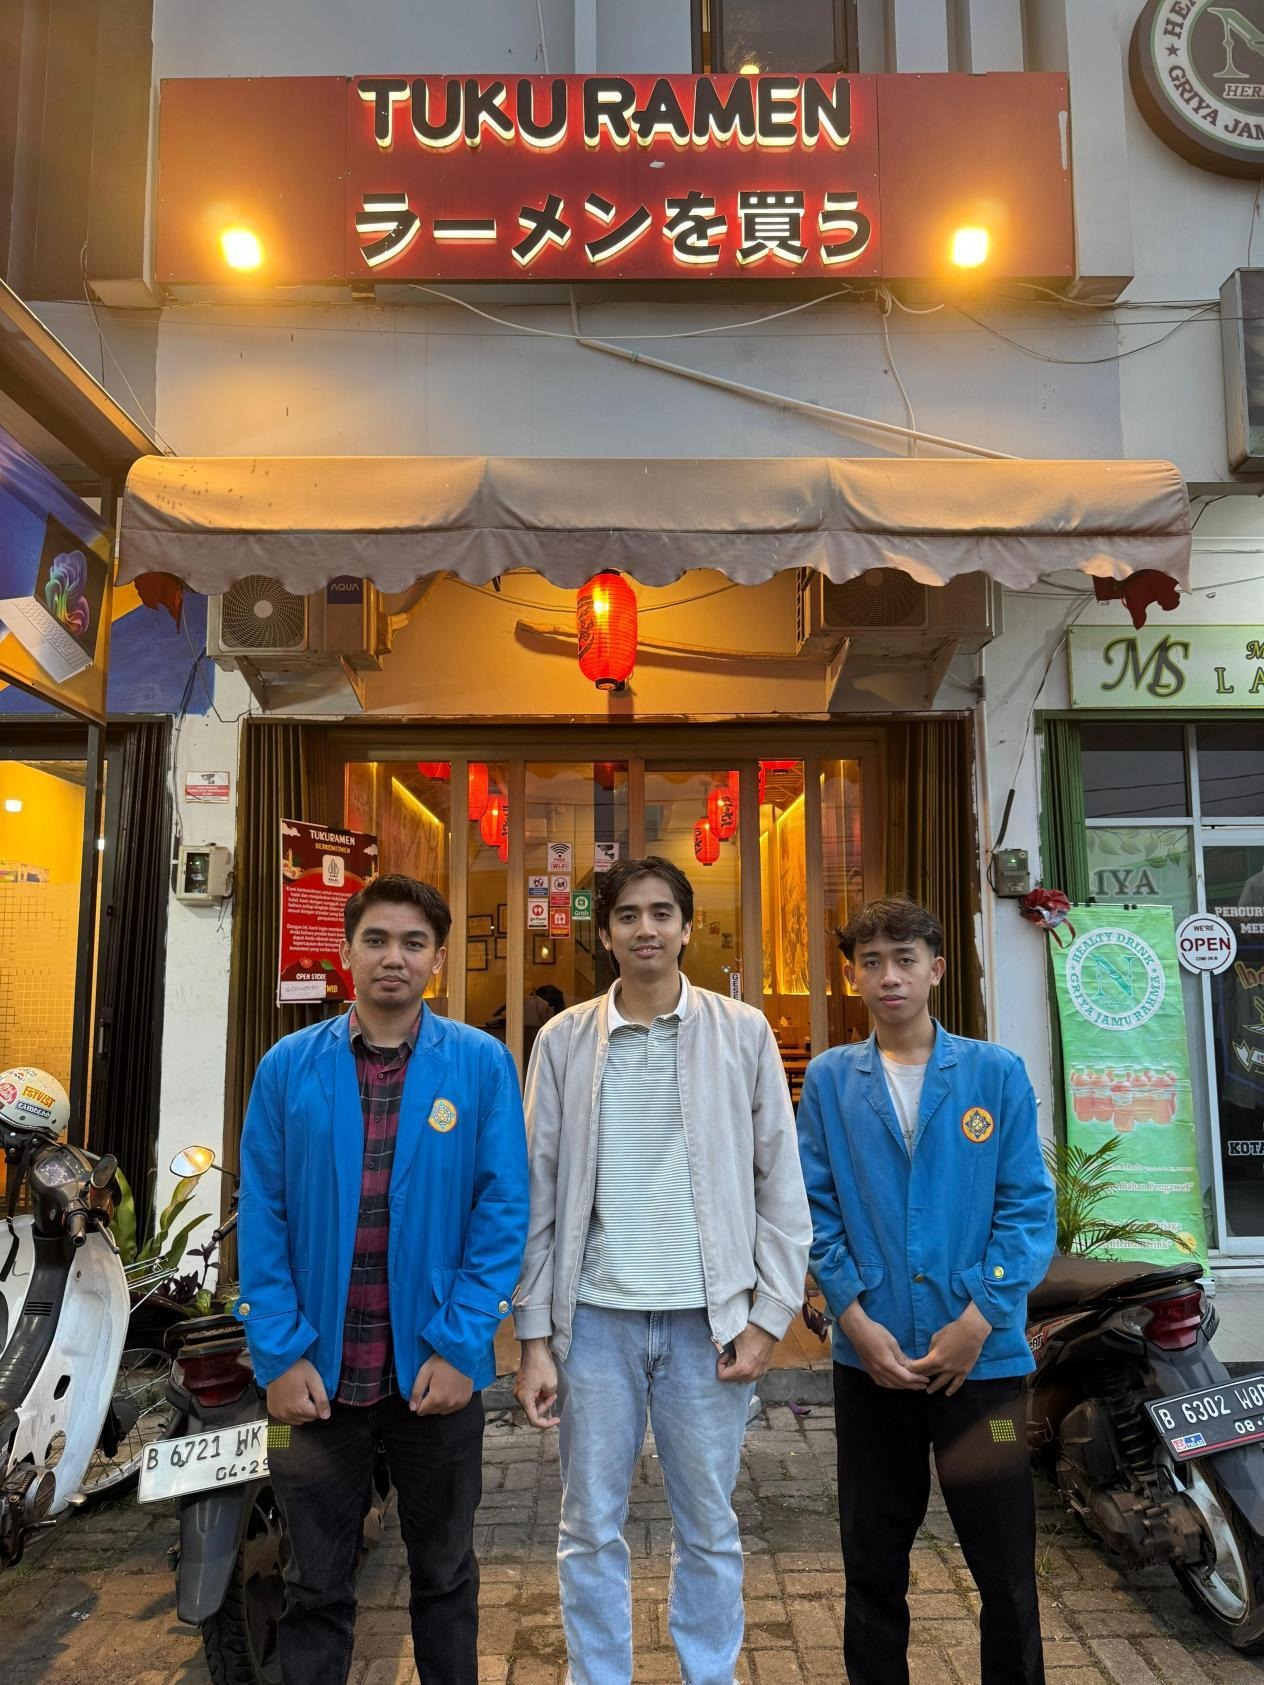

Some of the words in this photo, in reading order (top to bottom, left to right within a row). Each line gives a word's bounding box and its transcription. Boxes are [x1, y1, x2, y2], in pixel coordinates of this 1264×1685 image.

[357, 78, 569, 149] TUKU
[582, 77, 852, 149] RAMEN
[1168, 65, 1220, 127] GRIYA
[355, 190, 872, 268] ラーメンを買う
[330, 583, 360, 592] AQUA
[309, 829, 356, 846] TUKURAMEN
[1091, 868, 1160, 895] IYA
[1215, 906, 1264, 918] PERGUR
[1072, 932, 1112, 963] HEALTY
[1117, 933, 1155, 966] DRINK
[1180, 937, 1231, 952] OPEN
[1070, 972, 1094, 1017] GRIYA
[1094, 1012, 1132, 1026] JAMU
[1158, 1409, 1175, 1429] B
[1181, 1395, 1231, 1424] 6302
[146, 1448, 159, 1470] B
[170, 1435, 221, 1467] 6721
